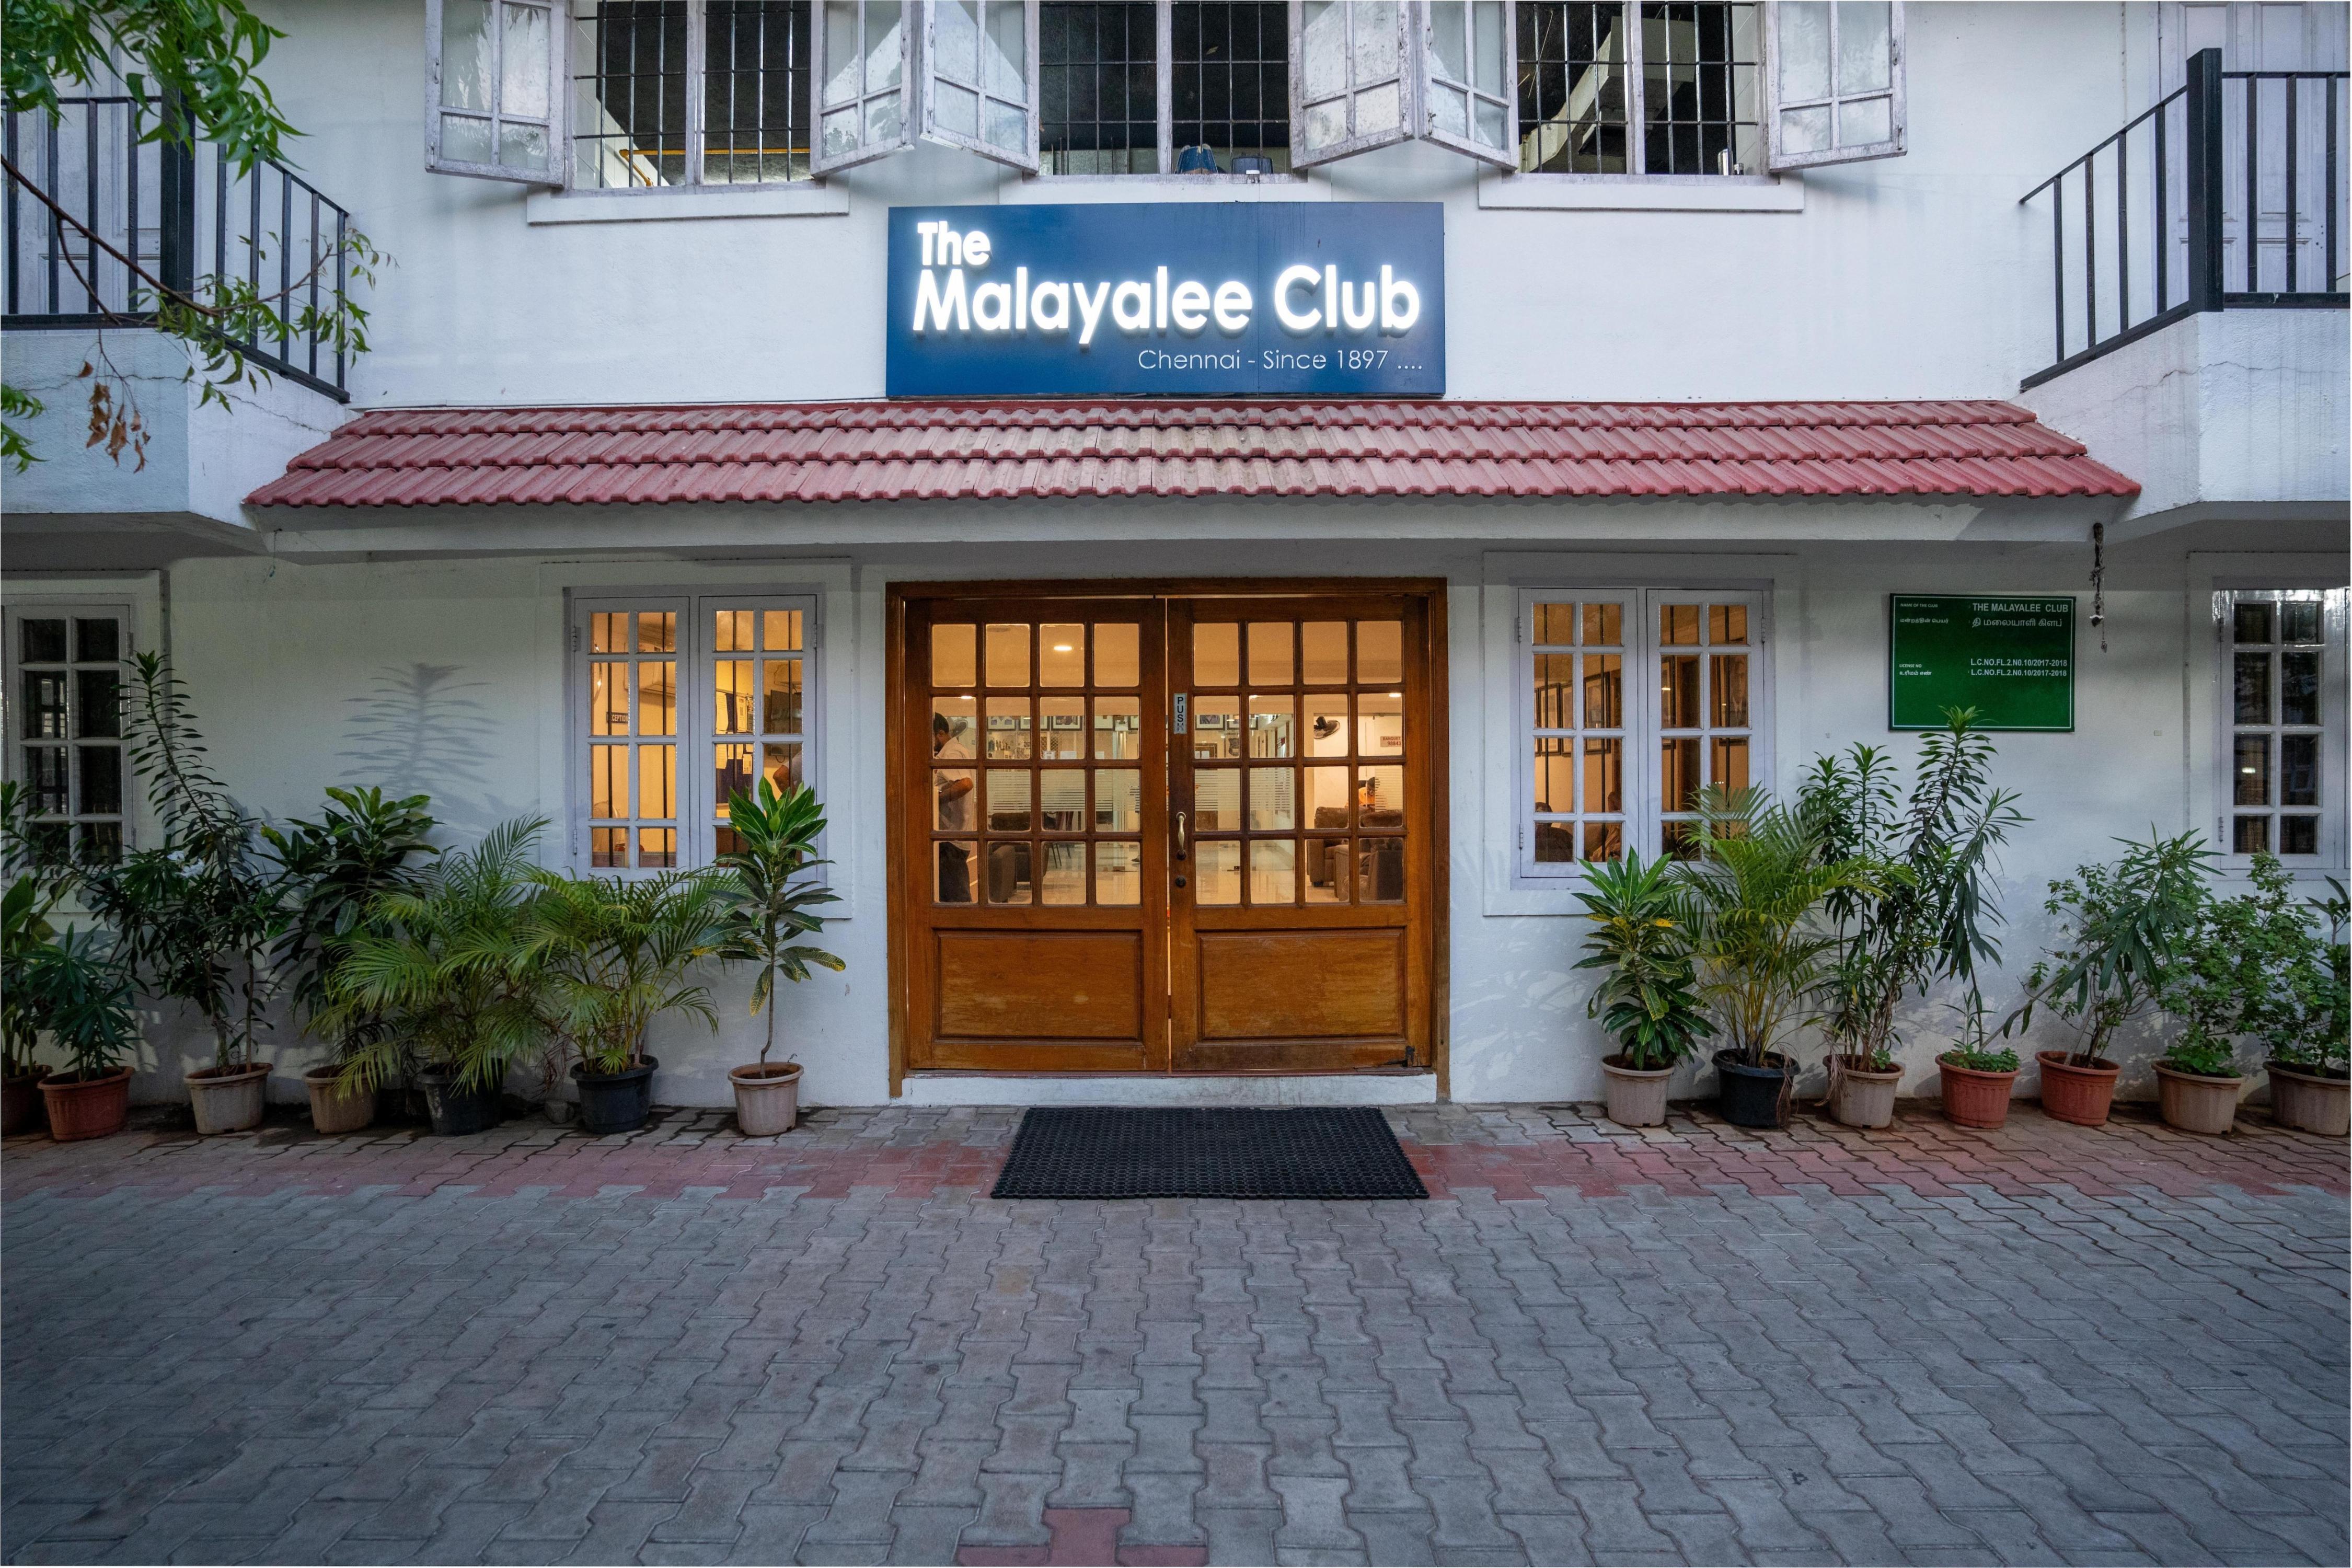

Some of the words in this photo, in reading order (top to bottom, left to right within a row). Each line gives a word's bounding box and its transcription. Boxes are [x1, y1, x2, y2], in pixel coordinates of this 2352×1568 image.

[917, 221, 991, 266] The
[912, 266, 1253, 345] Malayalee
[1274, 263, 1420, 330] Club
[1138, 349, 1240, 370] Chennai
[1263, 349, 1327, 370] Since
[1337, 349, 1389, 370] 1897
[1972, 603, 1989, 612] THE
[1991, 603, 2041, 613] MALAYALEE
[2045, 604, 2069, 613] CLUB
[1971, 617, 1981, 628] தி
[2038, 618, 2062, 627] கிளப்
